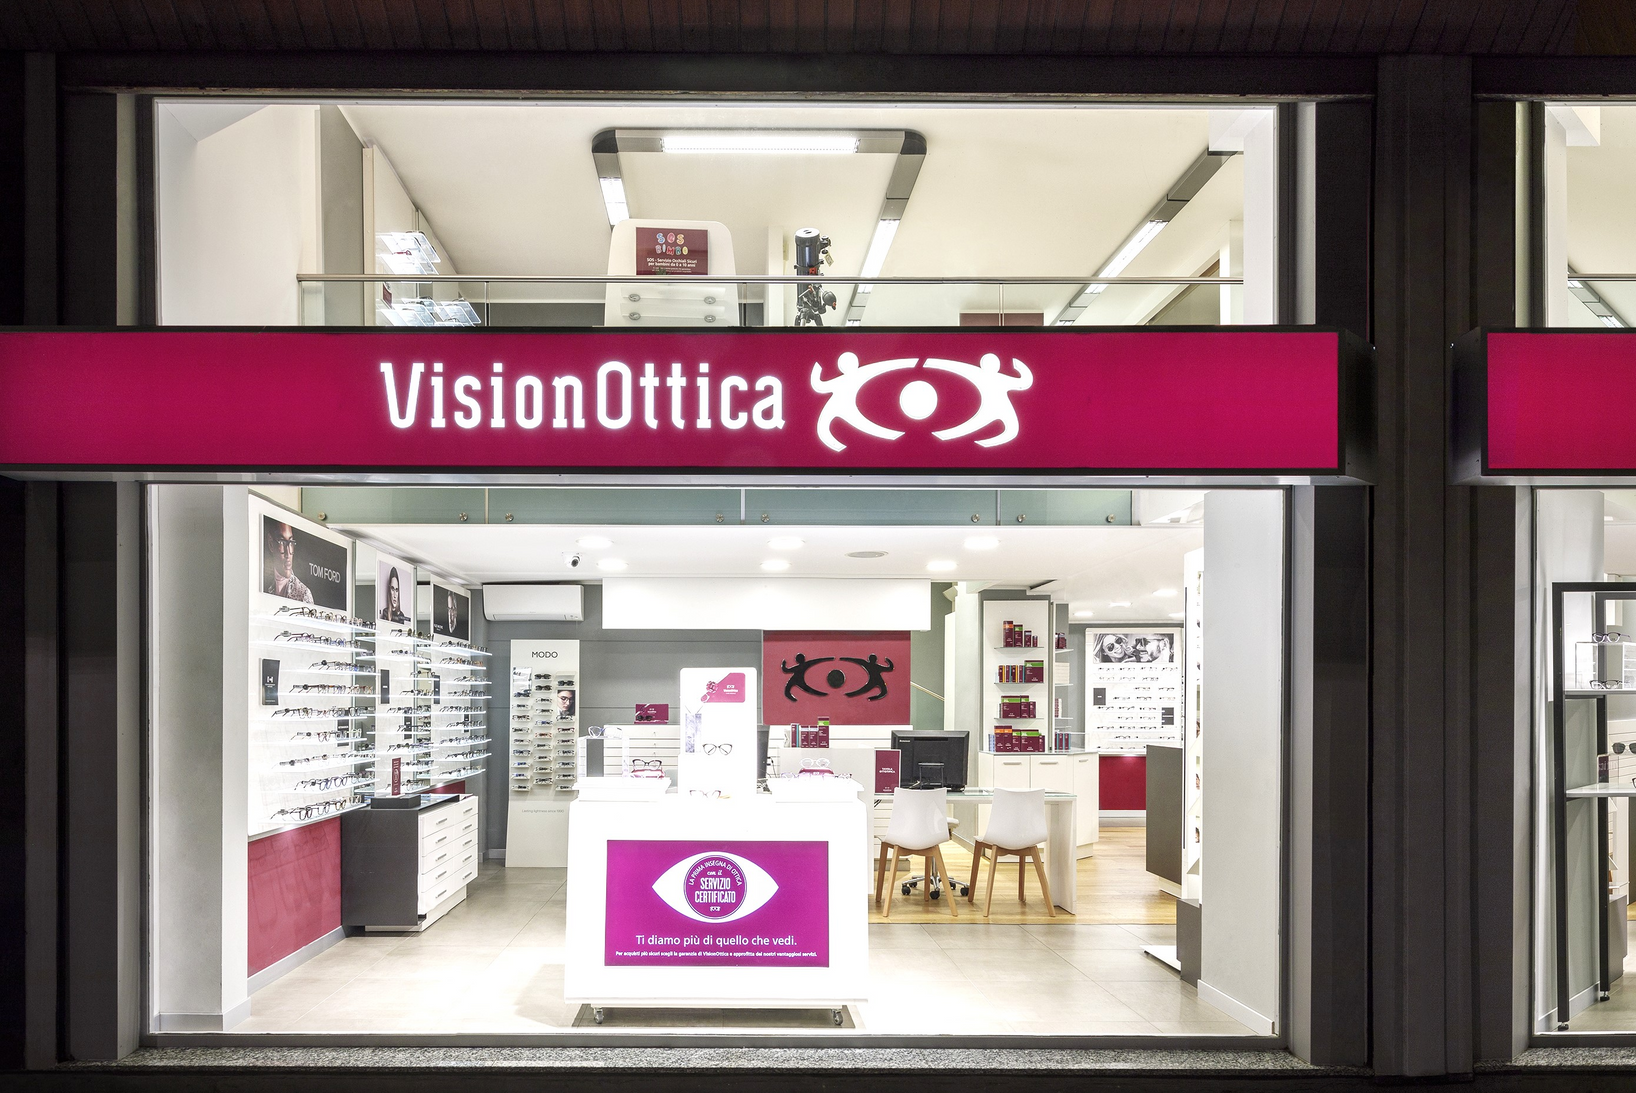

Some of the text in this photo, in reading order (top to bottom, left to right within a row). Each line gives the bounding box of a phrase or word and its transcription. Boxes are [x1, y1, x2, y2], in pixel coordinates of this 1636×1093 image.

[656, 232, 685, 245] SOS
[380, 360, 786, 430] VisionOttica
[309, 562, 341, 583] TOM FORD
[704, 860, 727, 868] INSEGNA
[691, 864, 705, 878] PRIMA
[731, 868, 743, 886] OTTICA
[688, 878, 695, 886] LA
[700, 877, 731, 890] SERVIZIO
[694, 891, 736, 903] CERTIFICATO
[635, 934, 797, 948] Ti diamo più di quello che vedi.
